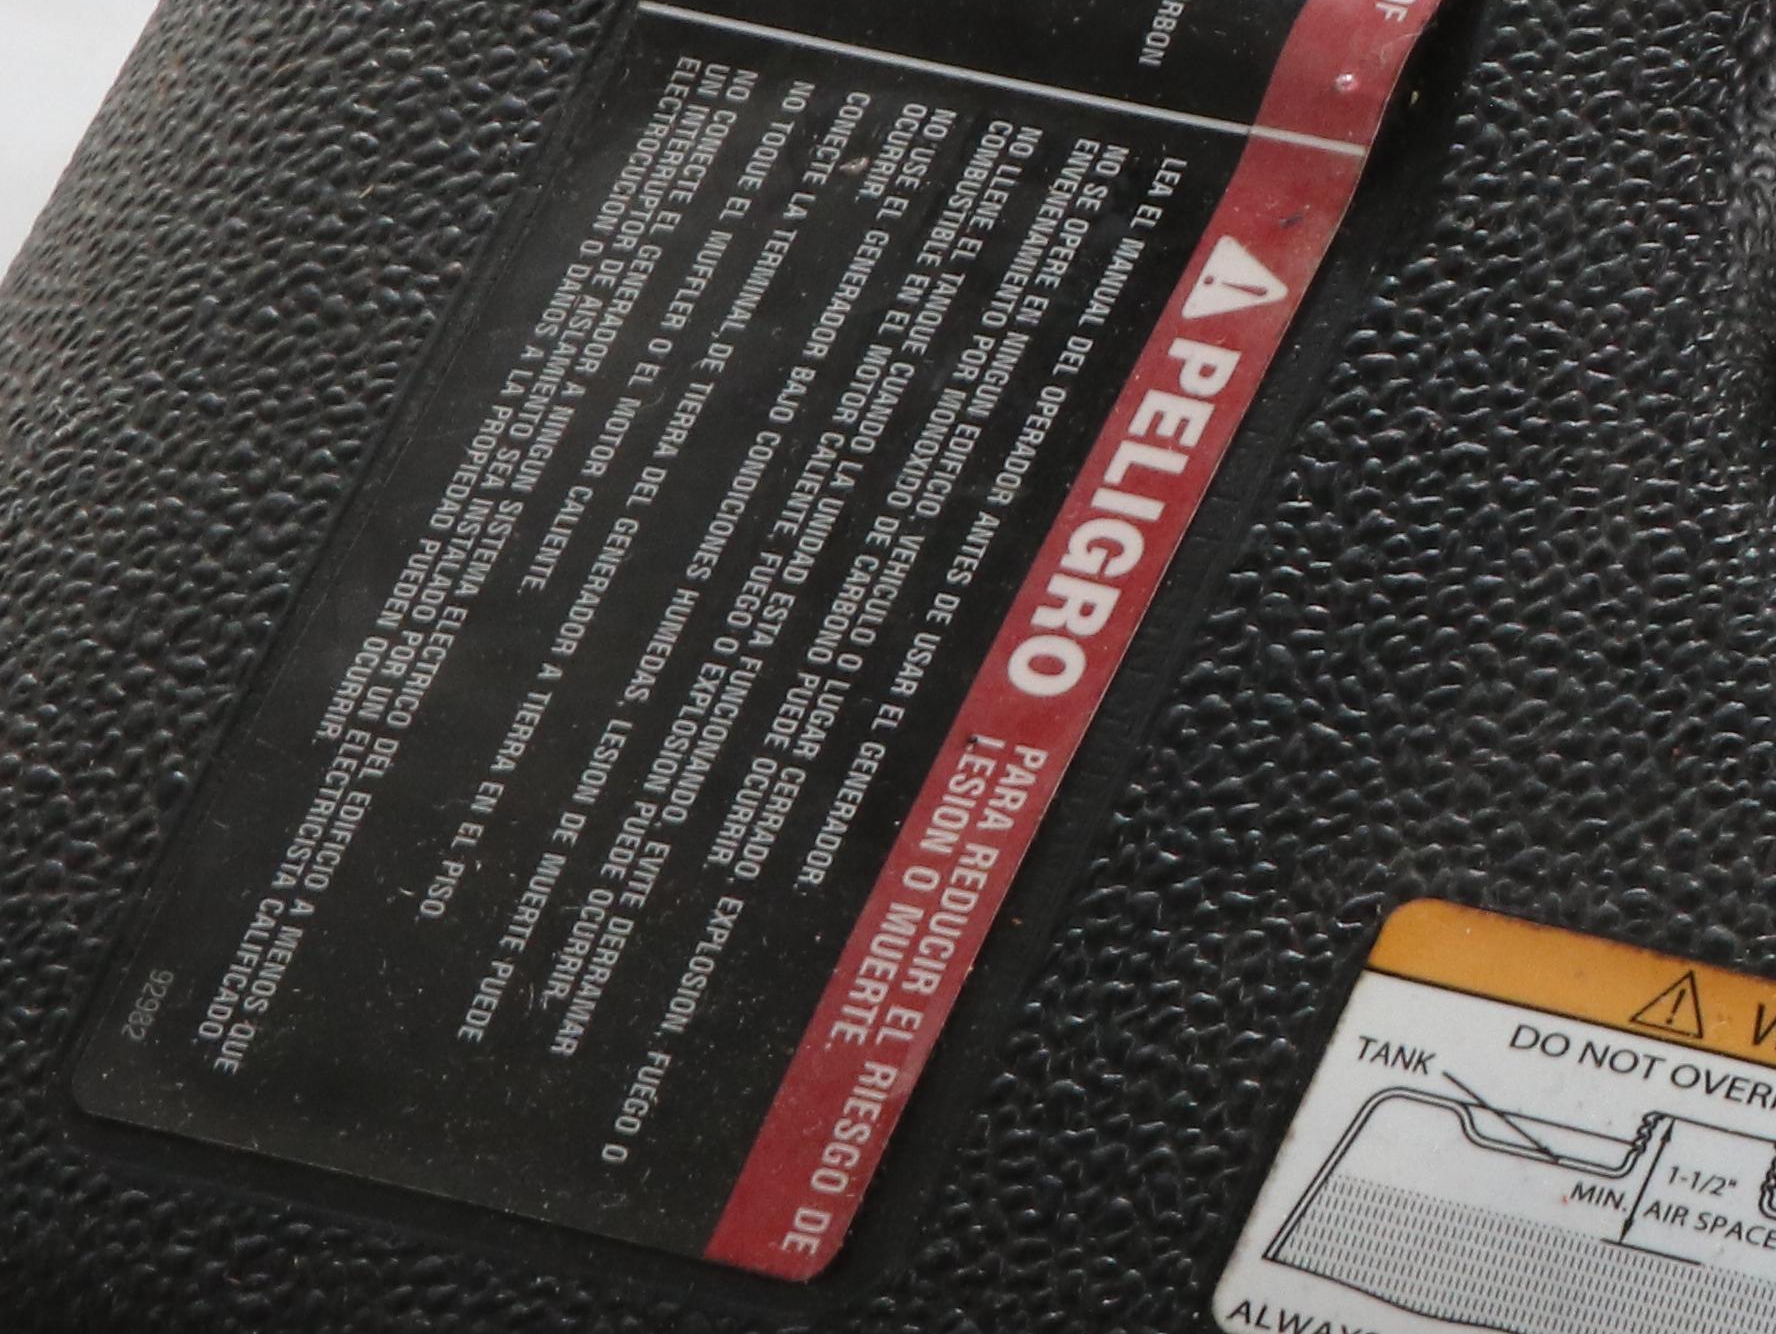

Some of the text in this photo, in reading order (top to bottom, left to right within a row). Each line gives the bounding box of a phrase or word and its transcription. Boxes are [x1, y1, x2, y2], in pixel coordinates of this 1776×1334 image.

[854, 102, 927, 200] OCURRIR.
[516, 80, 815, 593] NO TOQUE EL MUFFLER O EL MOTOR CALIENTE.
[1007, 337, 1241, 696] PELIGRO
[824, 734, 1005, 1049] LESION O MUERTE.
[120, 969, 174, 1041] 92982
[780, 744, 1048, 1255] PARA REDUCIR EL RIESGO DE
[1357, 1035, 1435, 1075] TANK
[1508, 1023, 1570, 1057] DO
[1577, 1040, 1666, 1080] NOT
[1569, 1181, 1626, 1212] MIN.
[1642, 1199, 1689, 1227] AIR
[1668, 1165, 1737, 1196] 1-1/2"
